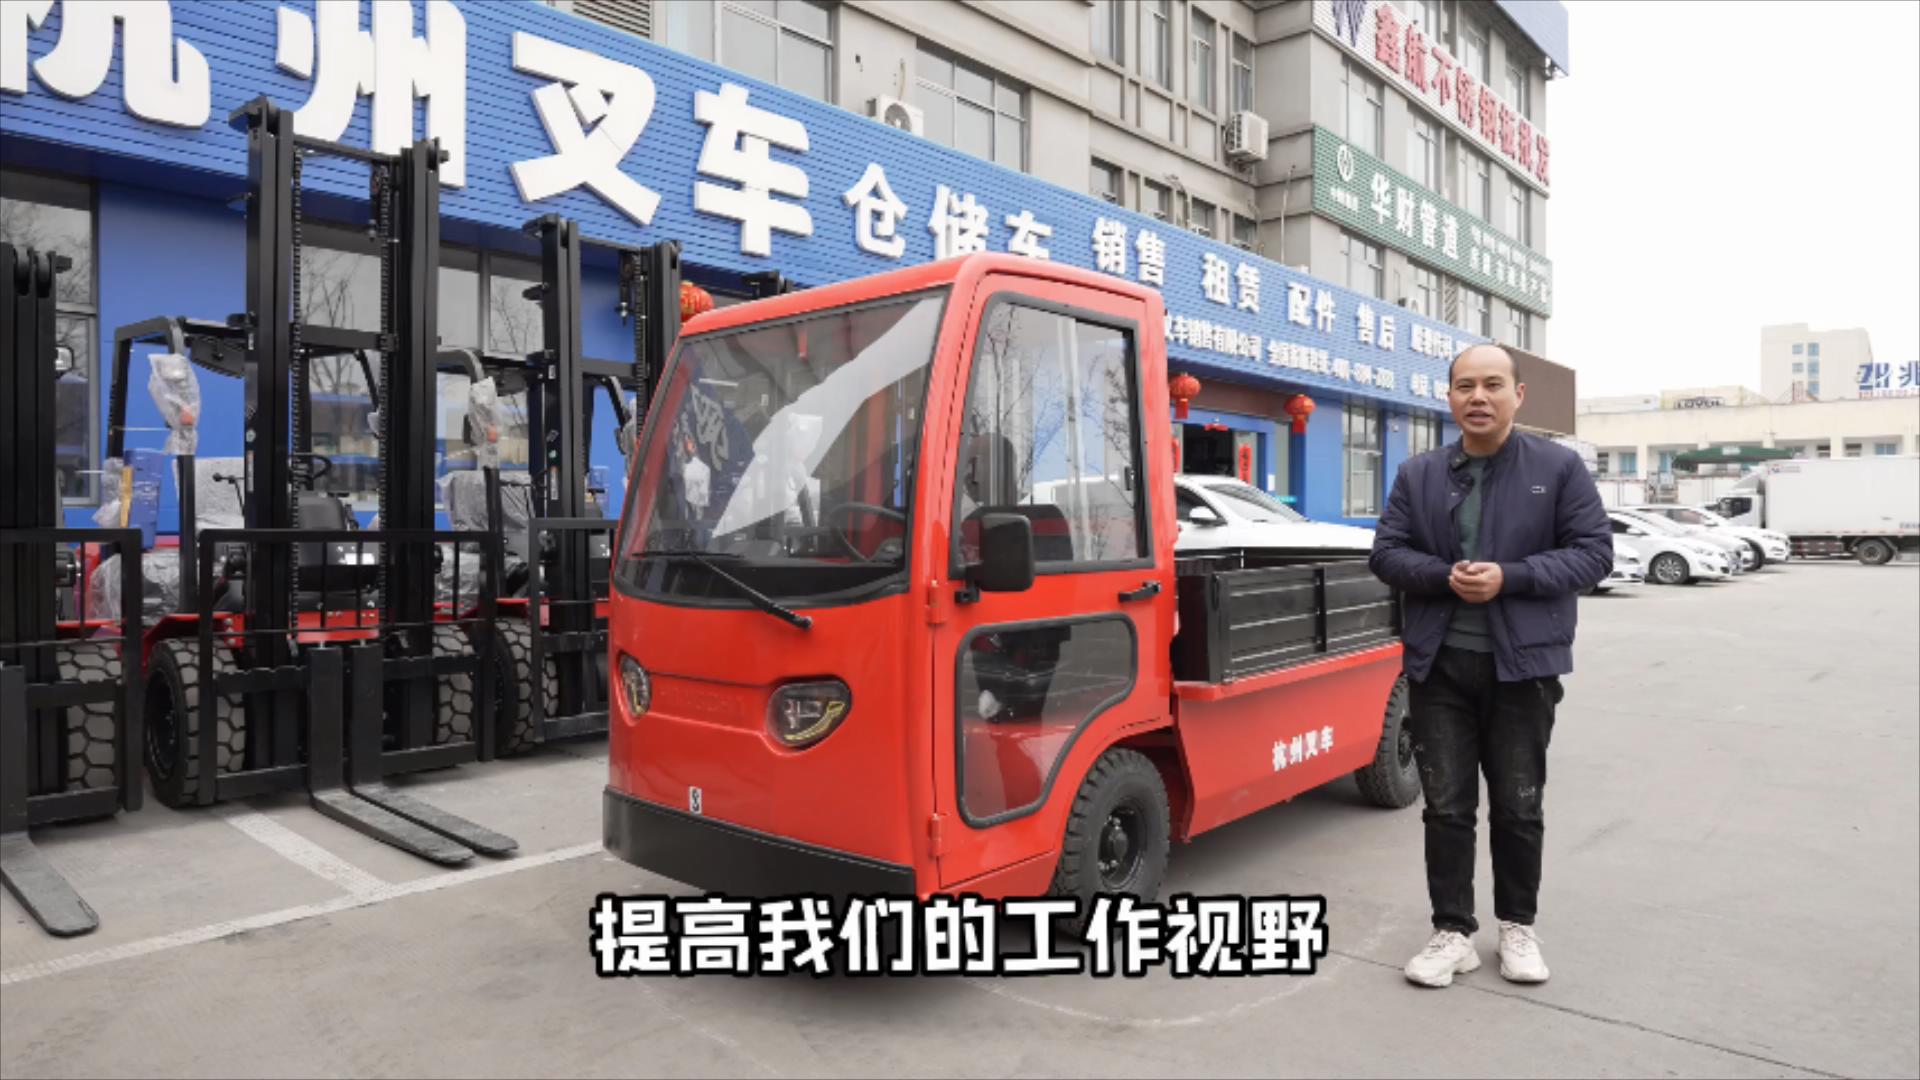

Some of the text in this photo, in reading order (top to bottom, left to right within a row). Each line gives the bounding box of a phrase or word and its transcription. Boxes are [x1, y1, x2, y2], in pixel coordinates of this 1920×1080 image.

[1092, 216, 1166, 287] 销售
[1201, 251, 1260, 313] 租赁
[1287, 281, 1336, 334] 配件
[1356, 301, 1396, 352] 售后
[1272, 725, 1333, 773] 杭州叉车
